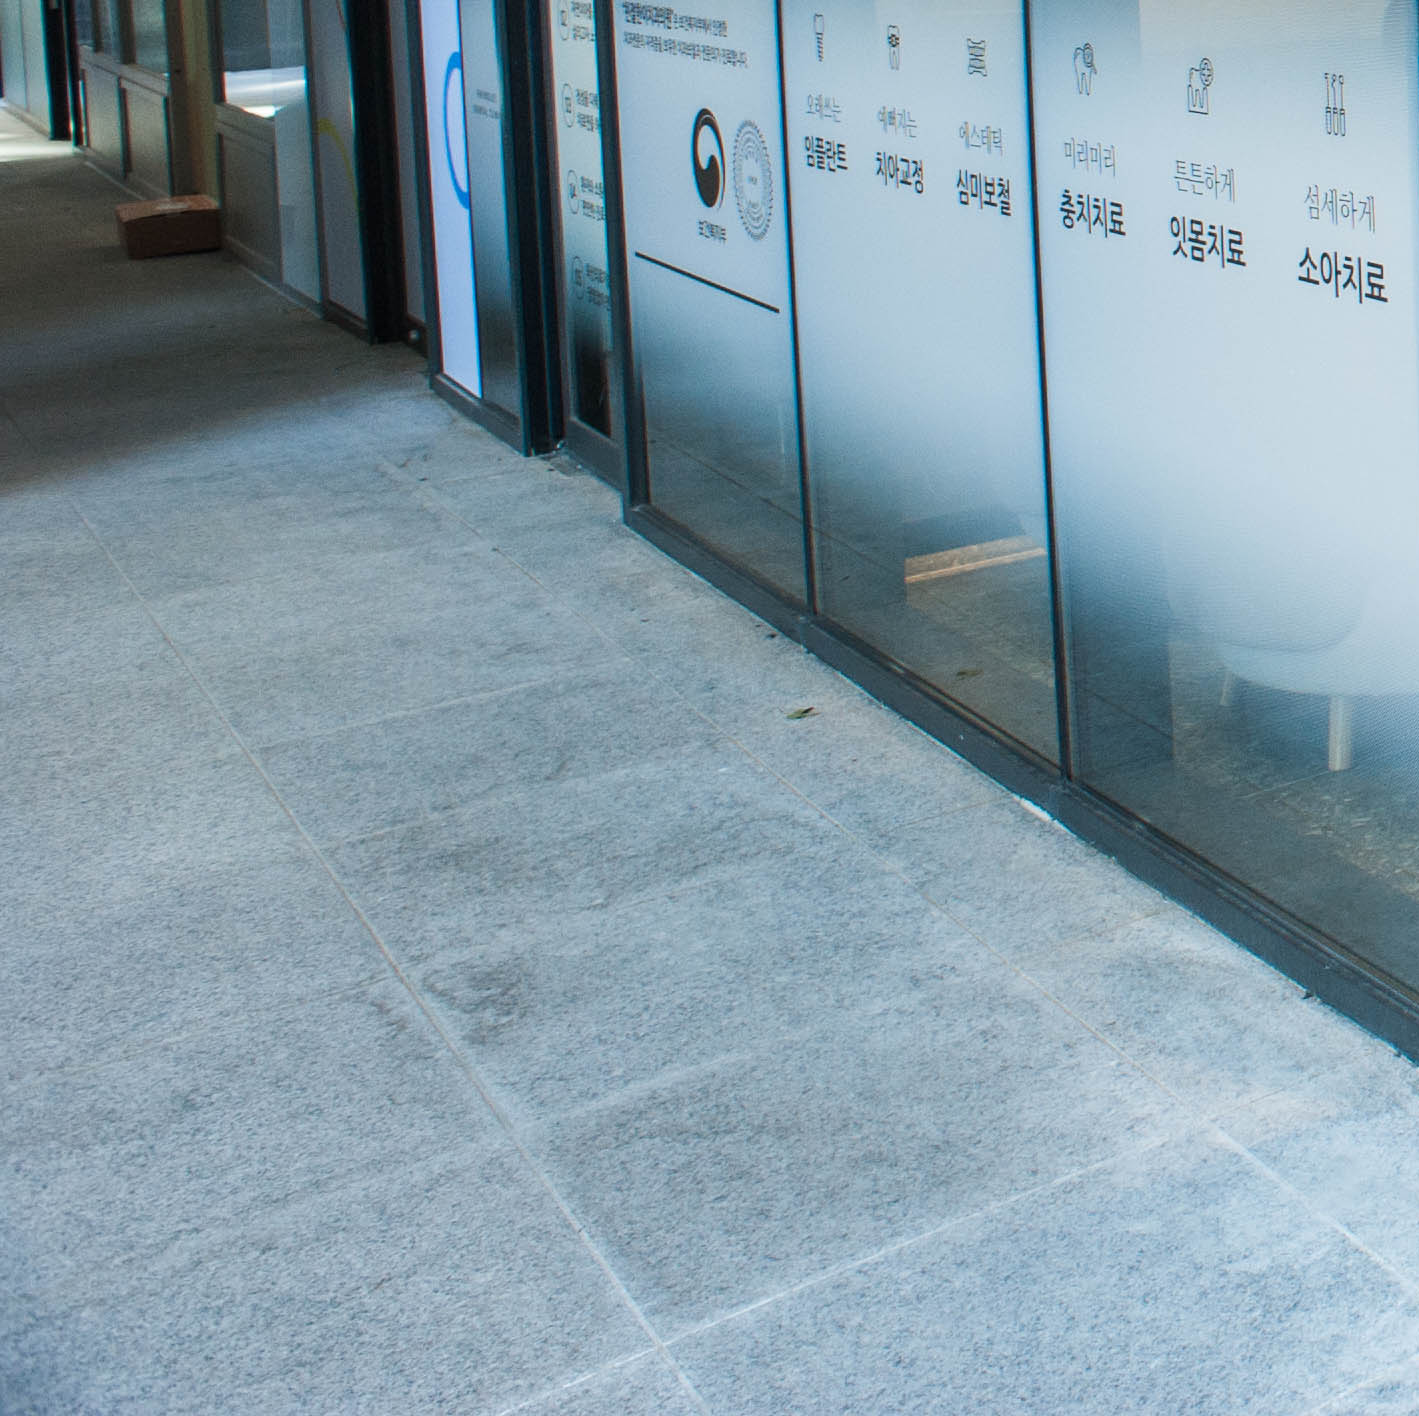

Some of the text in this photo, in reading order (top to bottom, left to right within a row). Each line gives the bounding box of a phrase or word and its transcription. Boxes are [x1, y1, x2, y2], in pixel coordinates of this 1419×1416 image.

[804, 136, 848, 172] 임플란트
[876, 151, 924, 194] 치아교정
[1064, 137, 1117, 177] 미리미리
[956, 168, 1012, 217] 심미보철
[1173, 159, 1236, 204] 튼튼하게
[1058, 188, 1126, 238] 충치치료
[1303, 184, 1376, 233] 섬세하게
[1169, 215, 1247, 269] 잇몸치료
[1298, 246, 1389, 304] 소아치료
